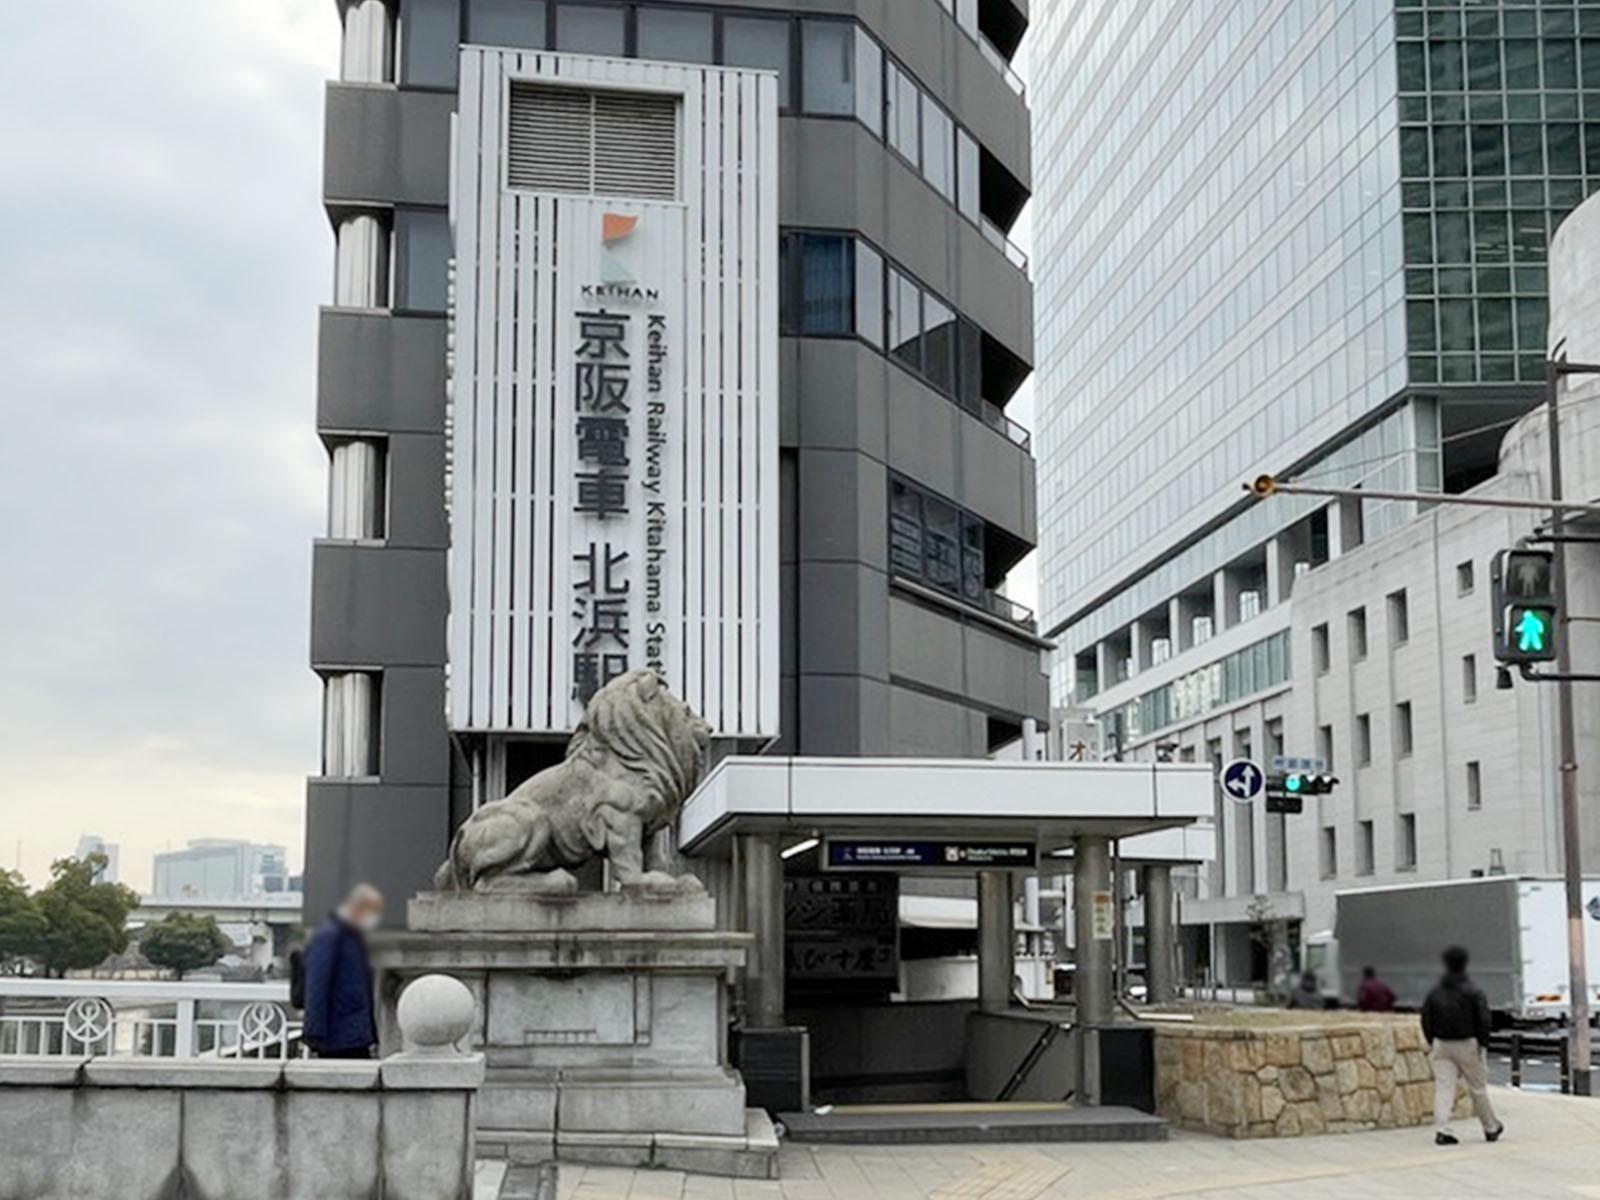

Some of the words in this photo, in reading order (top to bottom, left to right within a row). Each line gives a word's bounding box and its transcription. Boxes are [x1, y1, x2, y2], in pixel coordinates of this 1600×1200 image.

[581, 284, 660, 300] KEIHAN
[646, 313, 668, 393] Keihan
[574, 308, 631, 520] 京阪電車
[641, 401, 668, 494] Railway
[645, 501, 667, 613] Kitahama
[645, 621, 669, 685] Stat
